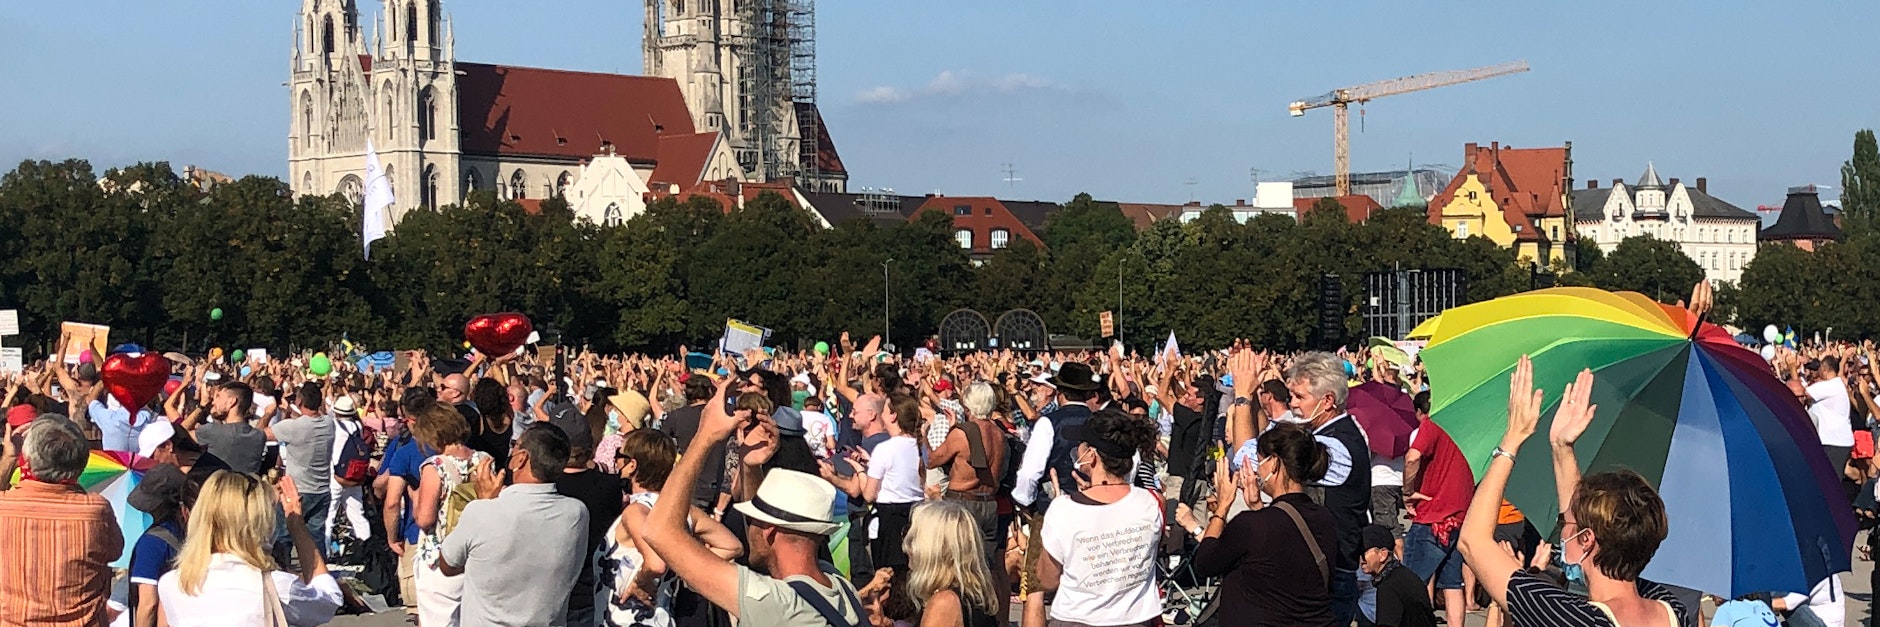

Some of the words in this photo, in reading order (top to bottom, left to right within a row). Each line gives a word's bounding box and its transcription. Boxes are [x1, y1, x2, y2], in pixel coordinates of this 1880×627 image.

[1116, 524, 1152, 536] Aufdecken
[1103, 536, 1143, 548] Verbrechen
[1097, 551, 1109, 559] ein
[1110, 543, 1149, 556] Verbrechen
[1092, 567, 1119, 577] werden
